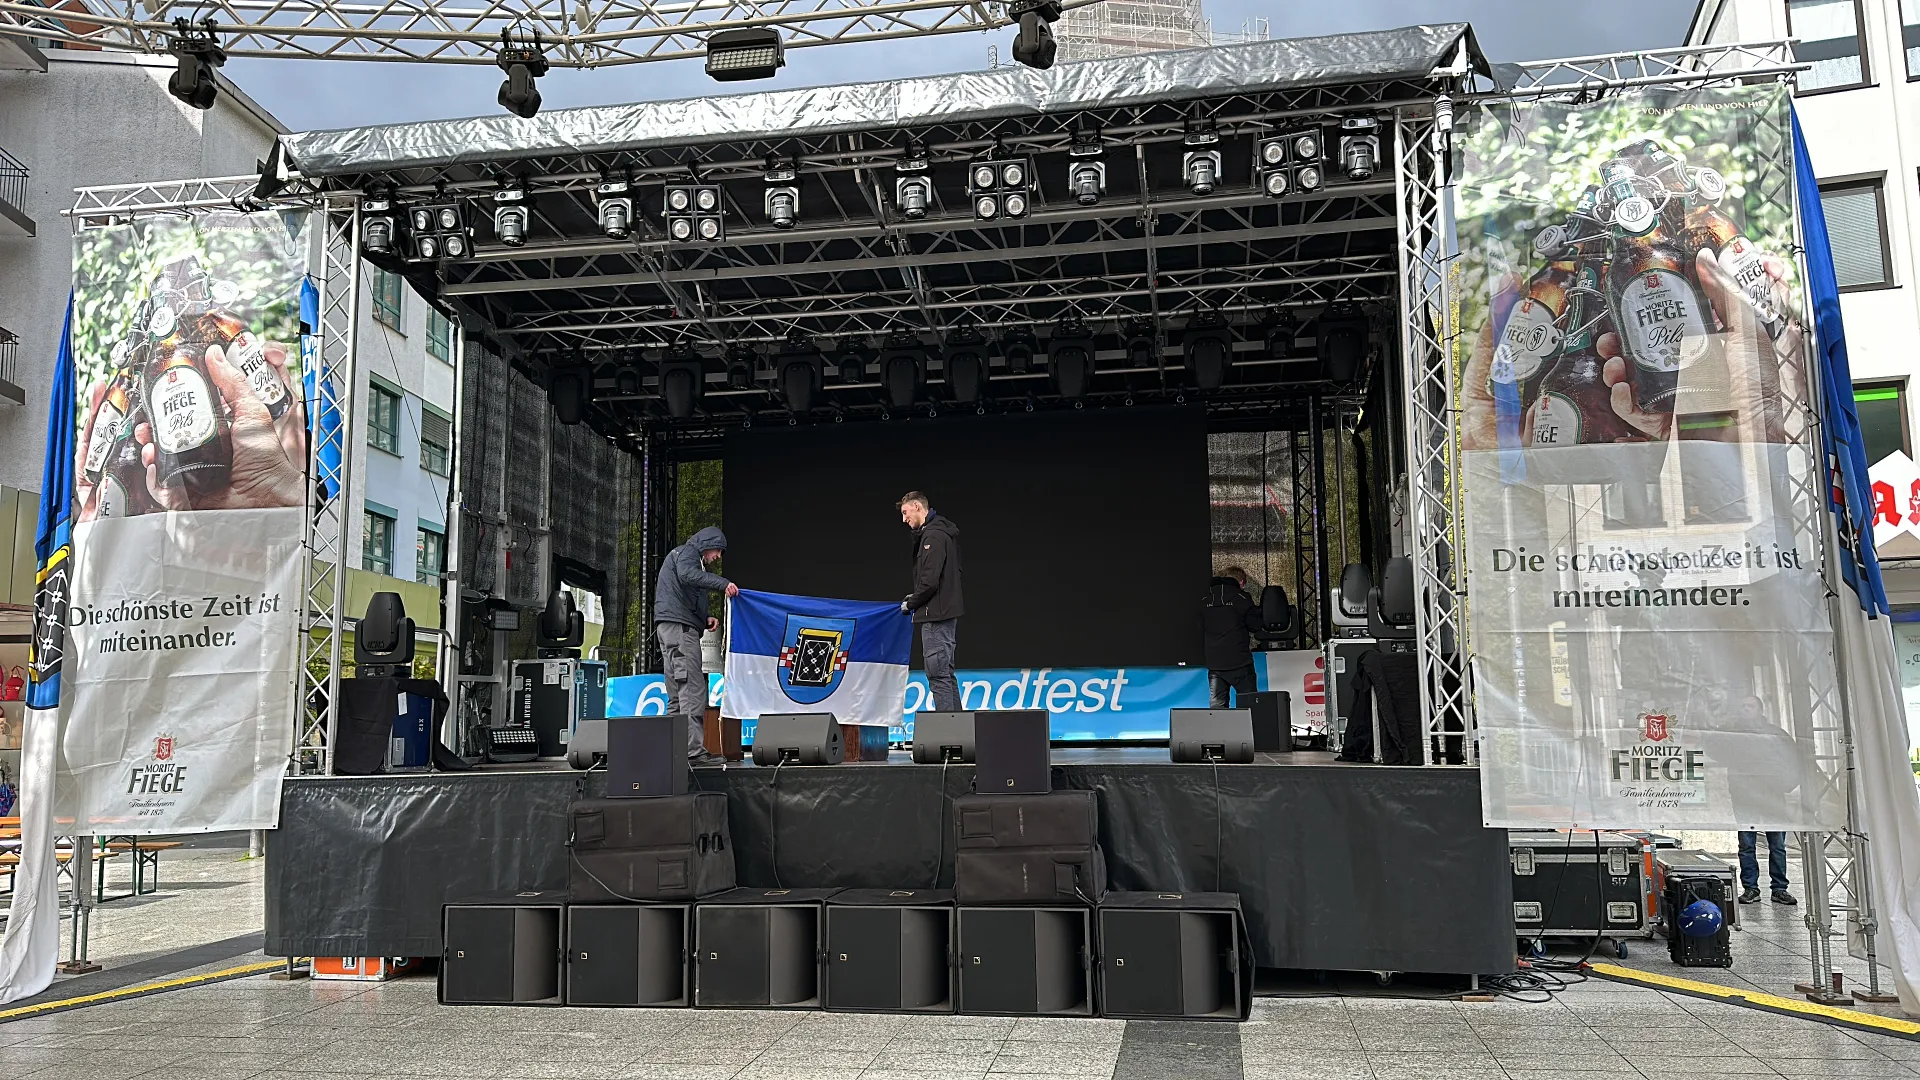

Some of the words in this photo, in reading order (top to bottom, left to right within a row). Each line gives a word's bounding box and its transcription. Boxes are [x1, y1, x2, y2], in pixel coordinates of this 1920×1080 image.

[1641, 107, 1661, 115] VON
[1747, 100, 1769, 108] HIER
[1733, 259, 1766, 290] FIEGE
[1749, 277, 1771, 307] Pils
[1636, 300, 1688, 328] FIEGE
[1645, 300, 1673, 311] MORITZ
[1647, 322, 1685, 349] Pils
[163, 391, 197, 417] FIEGE
[168, 410, 194, 434] Pils
[1492, 547, 1545, 573] Die
[1555, 546, 1691, 573] schönste
[1702, 542, 1766, 570] Zeit
[1775, 542, 1803, 571] ist
[1553, 580, 1750, 609] miteinander.
[69, 603, 102, 627] Die
[106, 600, 194, 623] schönste
[203, 594, 253, 618] Zeit
[258, 592, 281, 614] ist
[99, 626, 237, 654] miteinander.
[523, 693, 532, 718] HYBRID
[1632, 746, 1682, 756] MORITZ
[144, 763, 176, 773] MORITZ
[1610, 749, 1705, 782] FIEGE
[126, 766, 188, 796] FIEGE
[1620, 786, 1697, 798] Familienbrauerei
[1638, 799, 1654, 808] seit
[1656, 799, 1679, 808] 1878
[1611, 877, 1628, 887] 517
